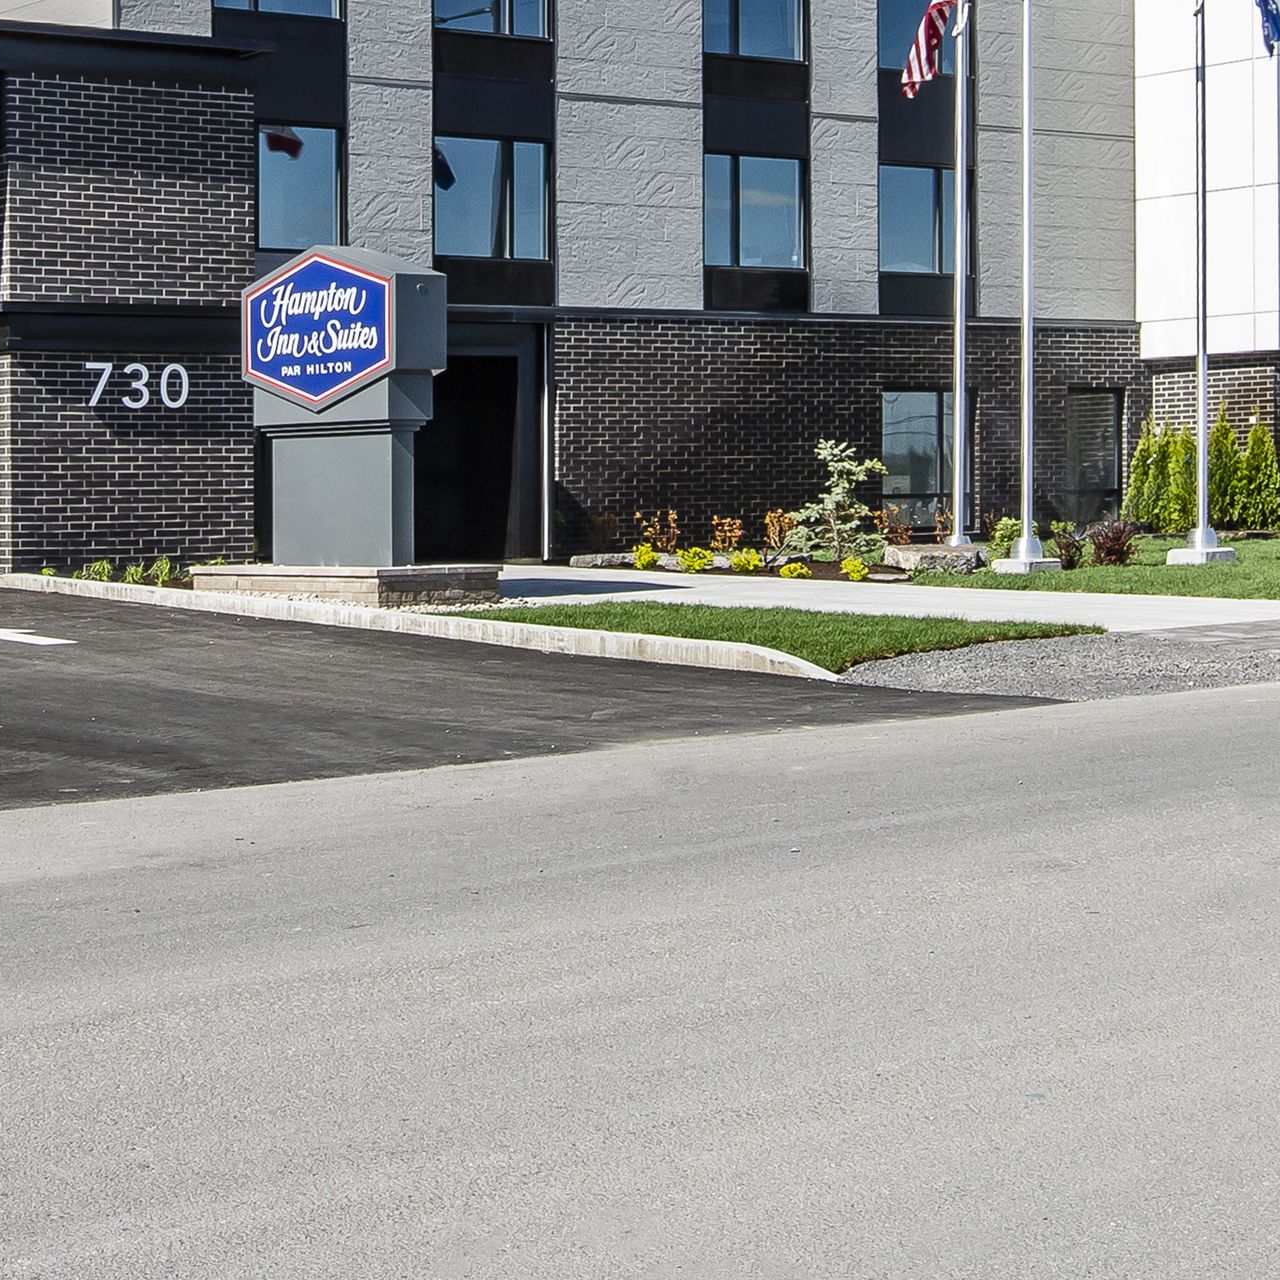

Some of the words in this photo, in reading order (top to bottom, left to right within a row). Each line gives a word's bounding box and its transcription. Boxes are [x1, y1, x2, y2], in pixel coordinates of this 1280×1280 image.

[260, 282, 367, 328] Hampton
[85, 361, 189, 409] 730
[281, 365, 301, 377] PAR
[306, 361, 352, 375] HILTON
